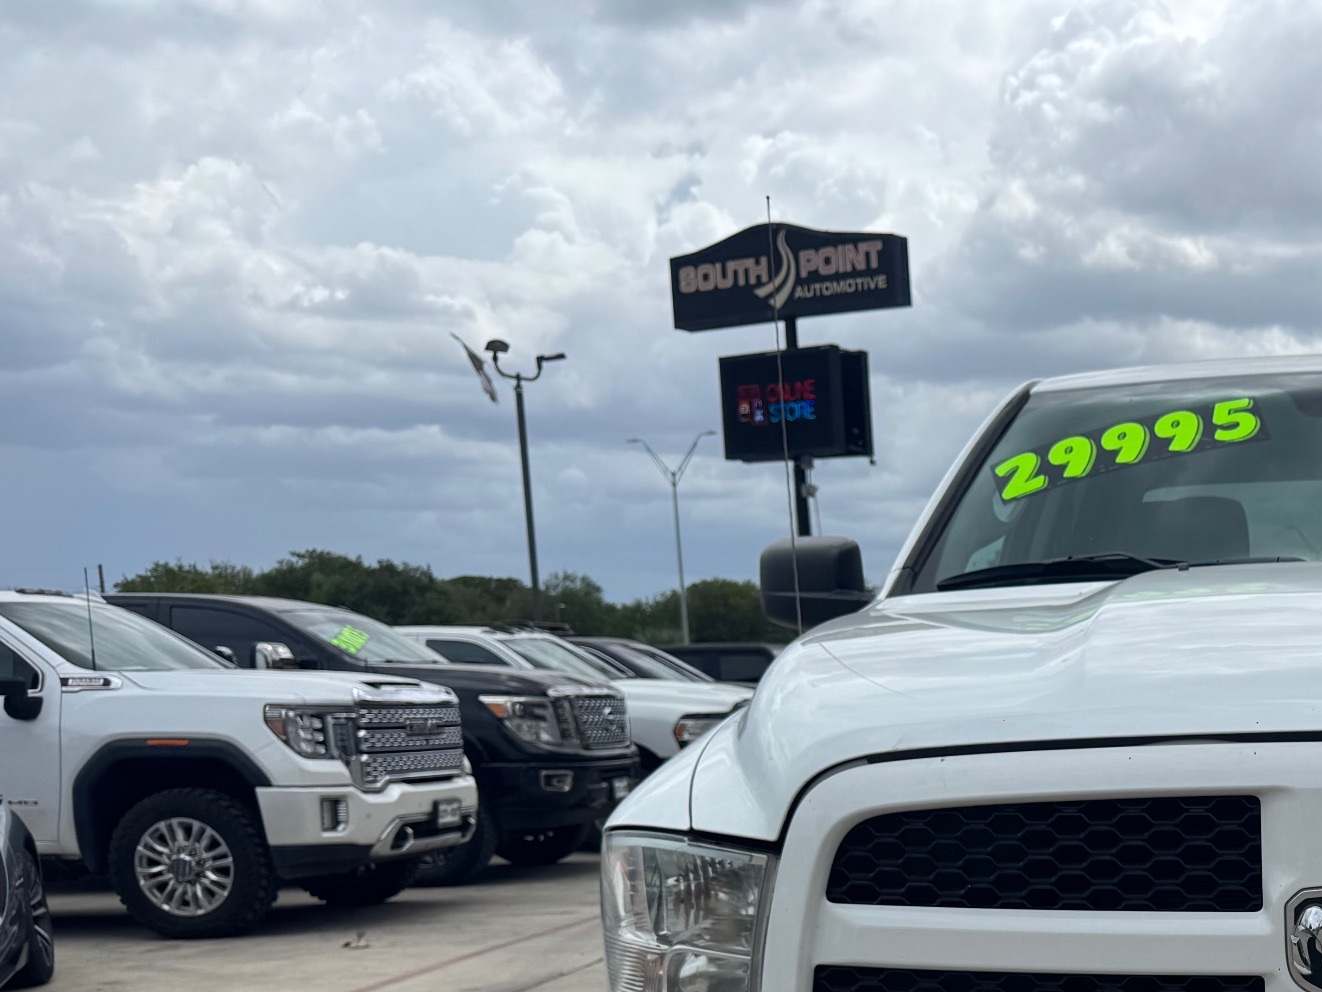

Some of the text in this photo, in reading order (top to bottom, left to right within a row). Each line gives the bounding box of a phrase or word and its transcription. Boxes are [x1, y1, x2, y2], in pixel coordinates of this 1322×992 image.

[678, 240, 882, 293] SOUTH POINT
[795, 275, 887, 299] AUTOMOTIVE
[995, 398, 1261, 501] 29995
